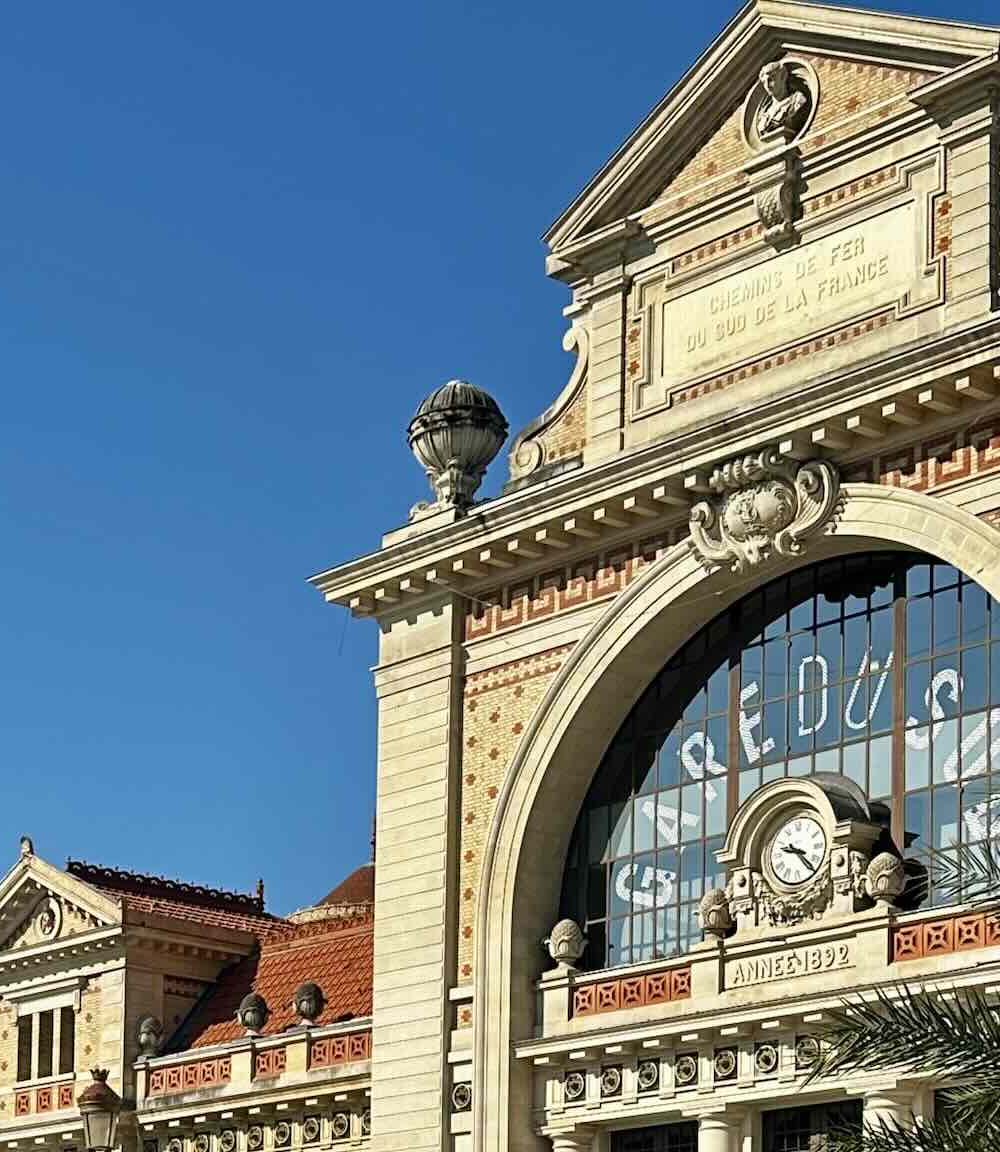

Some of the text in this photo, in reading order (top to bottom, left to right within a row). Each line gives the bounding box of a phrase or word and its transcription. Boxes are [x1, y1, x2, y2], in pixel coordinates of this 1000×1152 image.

[687, 254, 890, 352] DU SUD DE LA FRANCE
[709, 235, 866, 315] CHEMINS DE FER
[614, 680, 777, 908] GARE
[798, 643, 896, 738] DU
[804, 943, 850, 972] 1892
